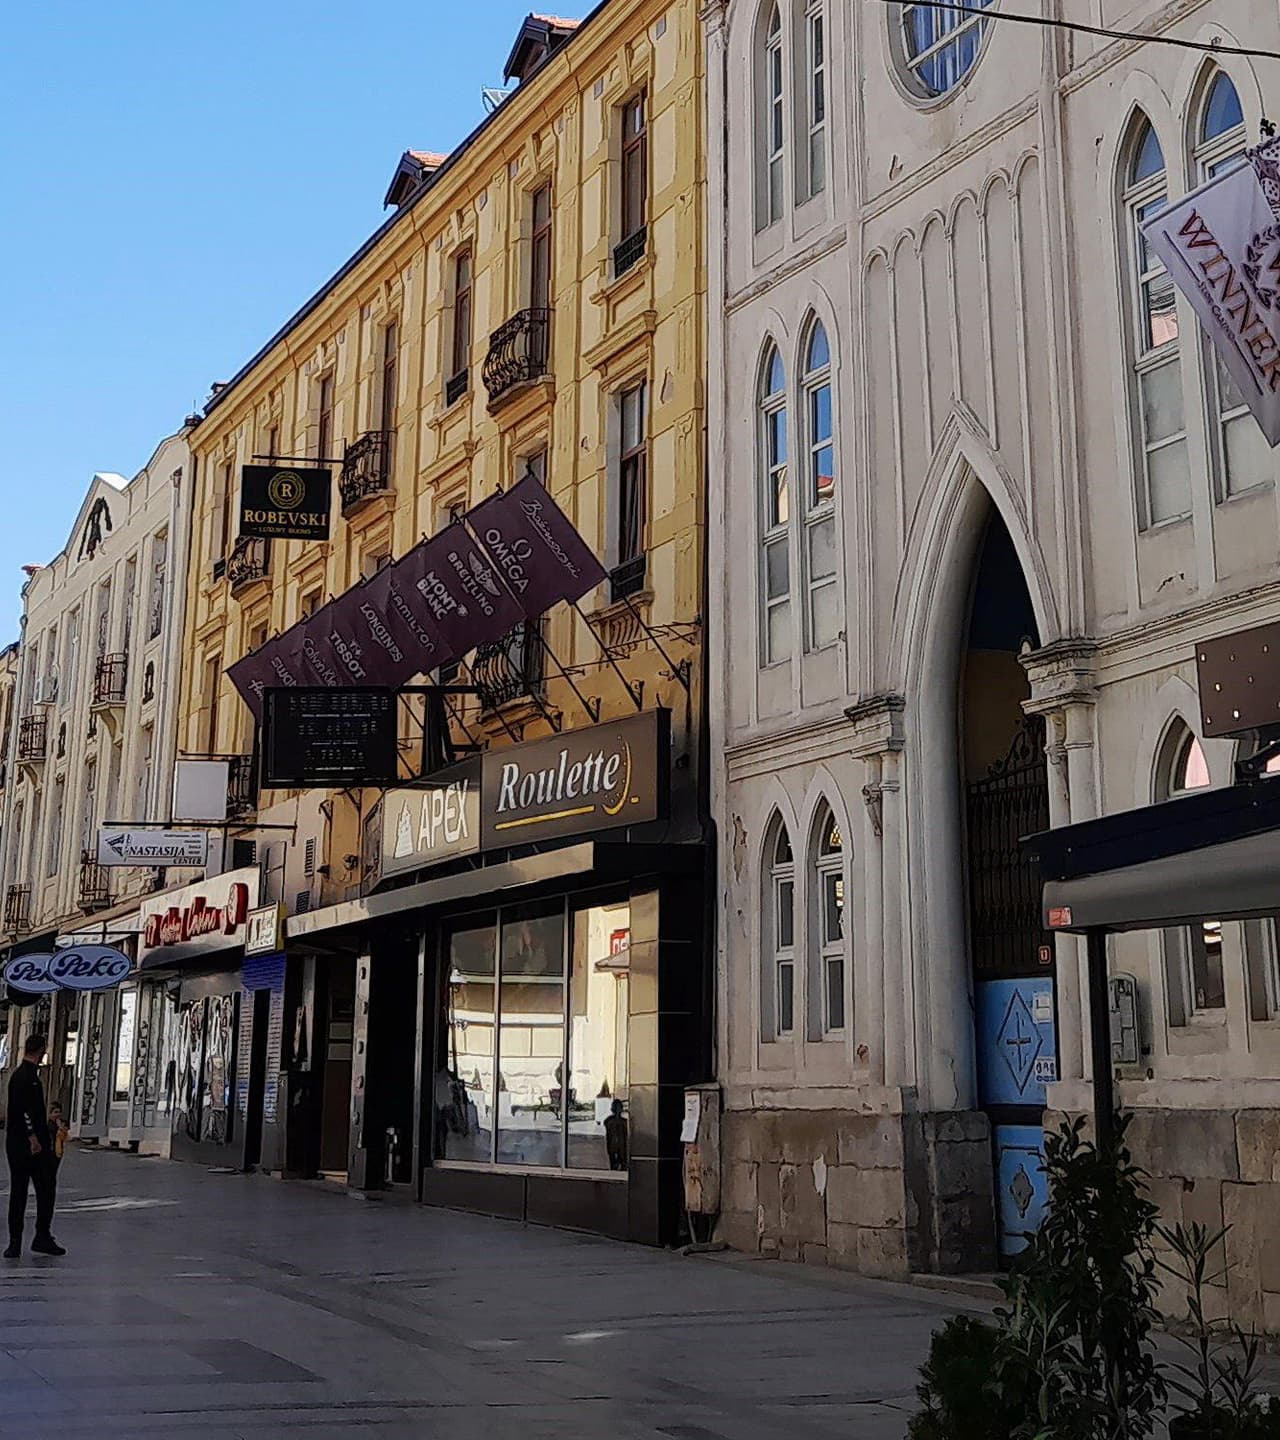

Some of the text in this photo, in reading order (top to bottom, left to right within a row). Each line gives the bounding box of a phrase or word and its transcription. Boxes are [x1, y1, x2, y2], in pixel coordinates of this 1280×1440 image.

[243, 509, 328, 527] ROBEVSKI
[447, 551, 495, 617] BREITLING
[485, 528, 530, 594] OMEGA
[415, 578, 449, 621] BLANC
[424, 570, 459, 612] MONT
[328, 629, 367, 680] TISSOT
[360, 602, 404, 664] LONGINES
[495, 749, 621, 813] Roulette
[416, 778, 470, 853] APEX
[53, 953, 128, 977] Peko
